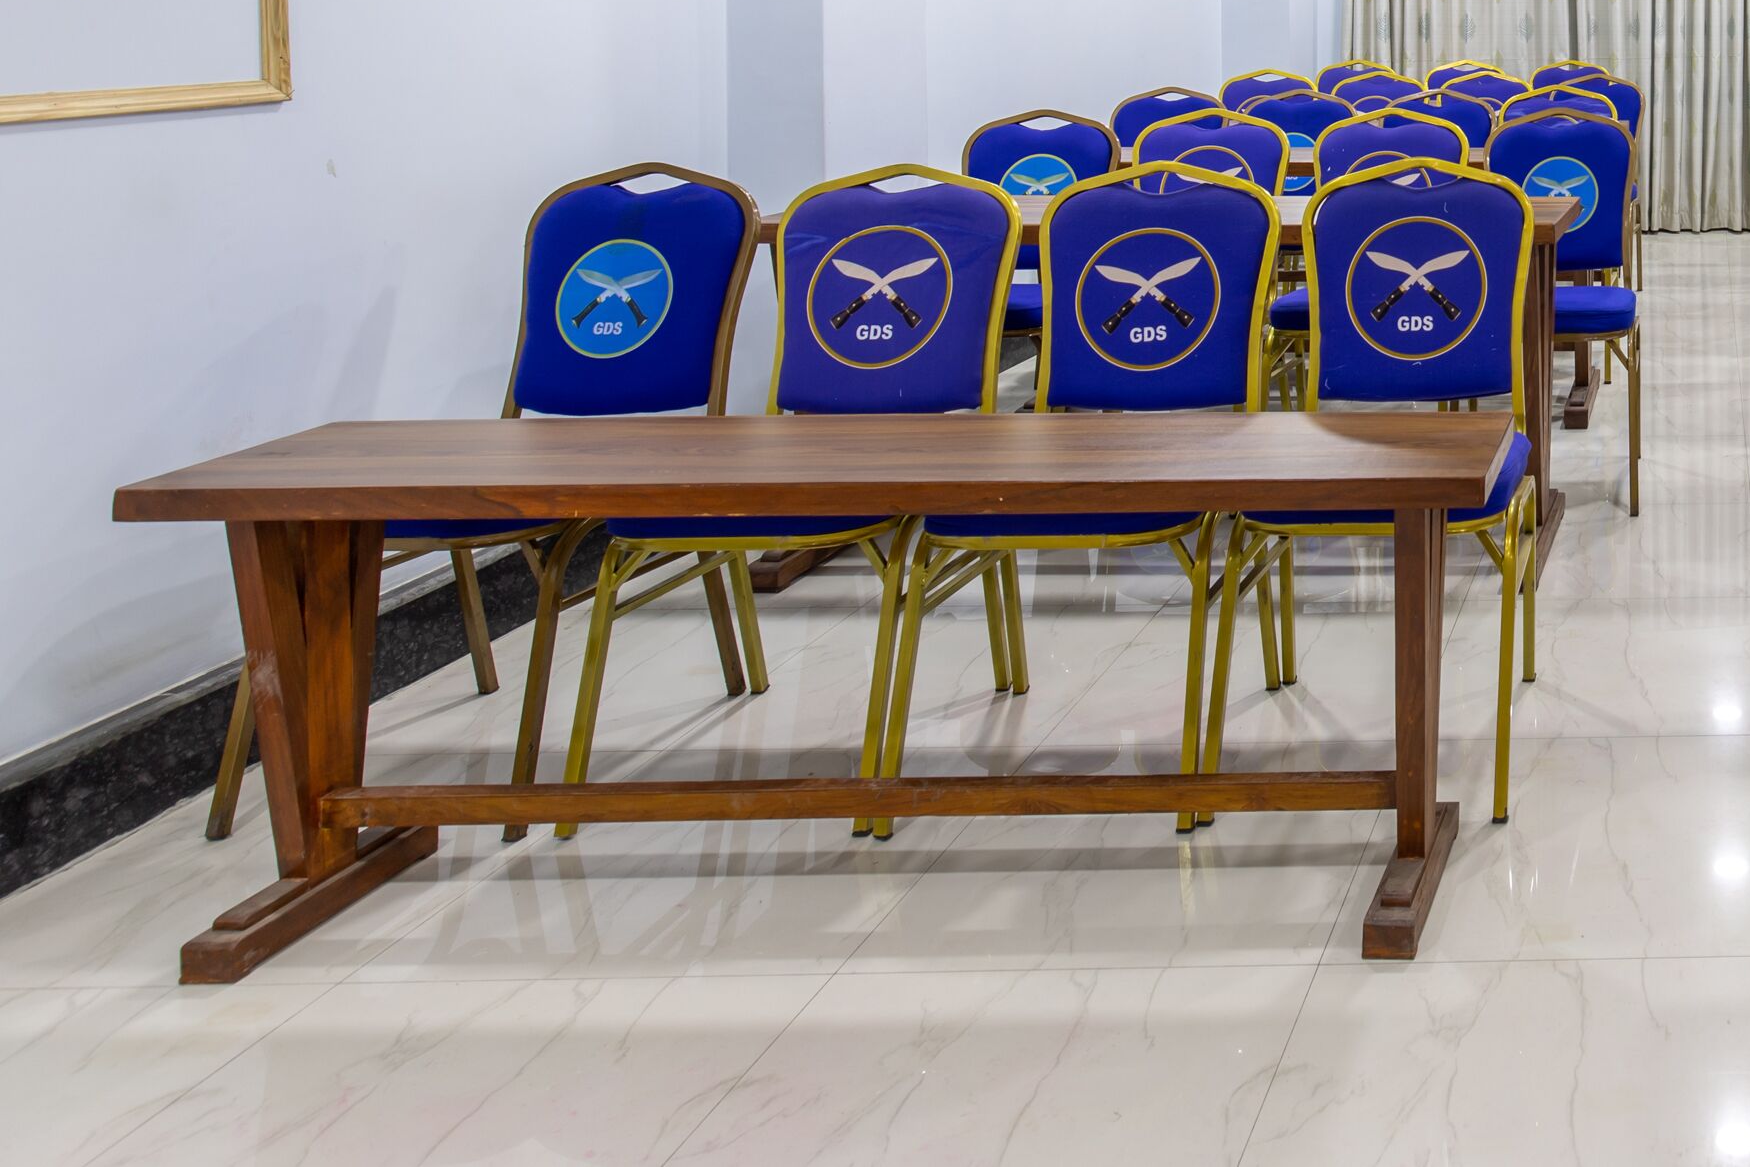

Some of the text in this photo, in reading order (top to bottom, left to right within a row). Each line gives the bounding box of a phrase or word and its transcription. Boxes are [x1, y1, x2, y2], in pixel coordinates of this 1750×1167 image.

[593, 321, 623, 335] GDS
[1397, 315, 1434, 332] GDS
[856, 324, 893, 341] GDS
[1129, 325, 1167, 343] GDS
